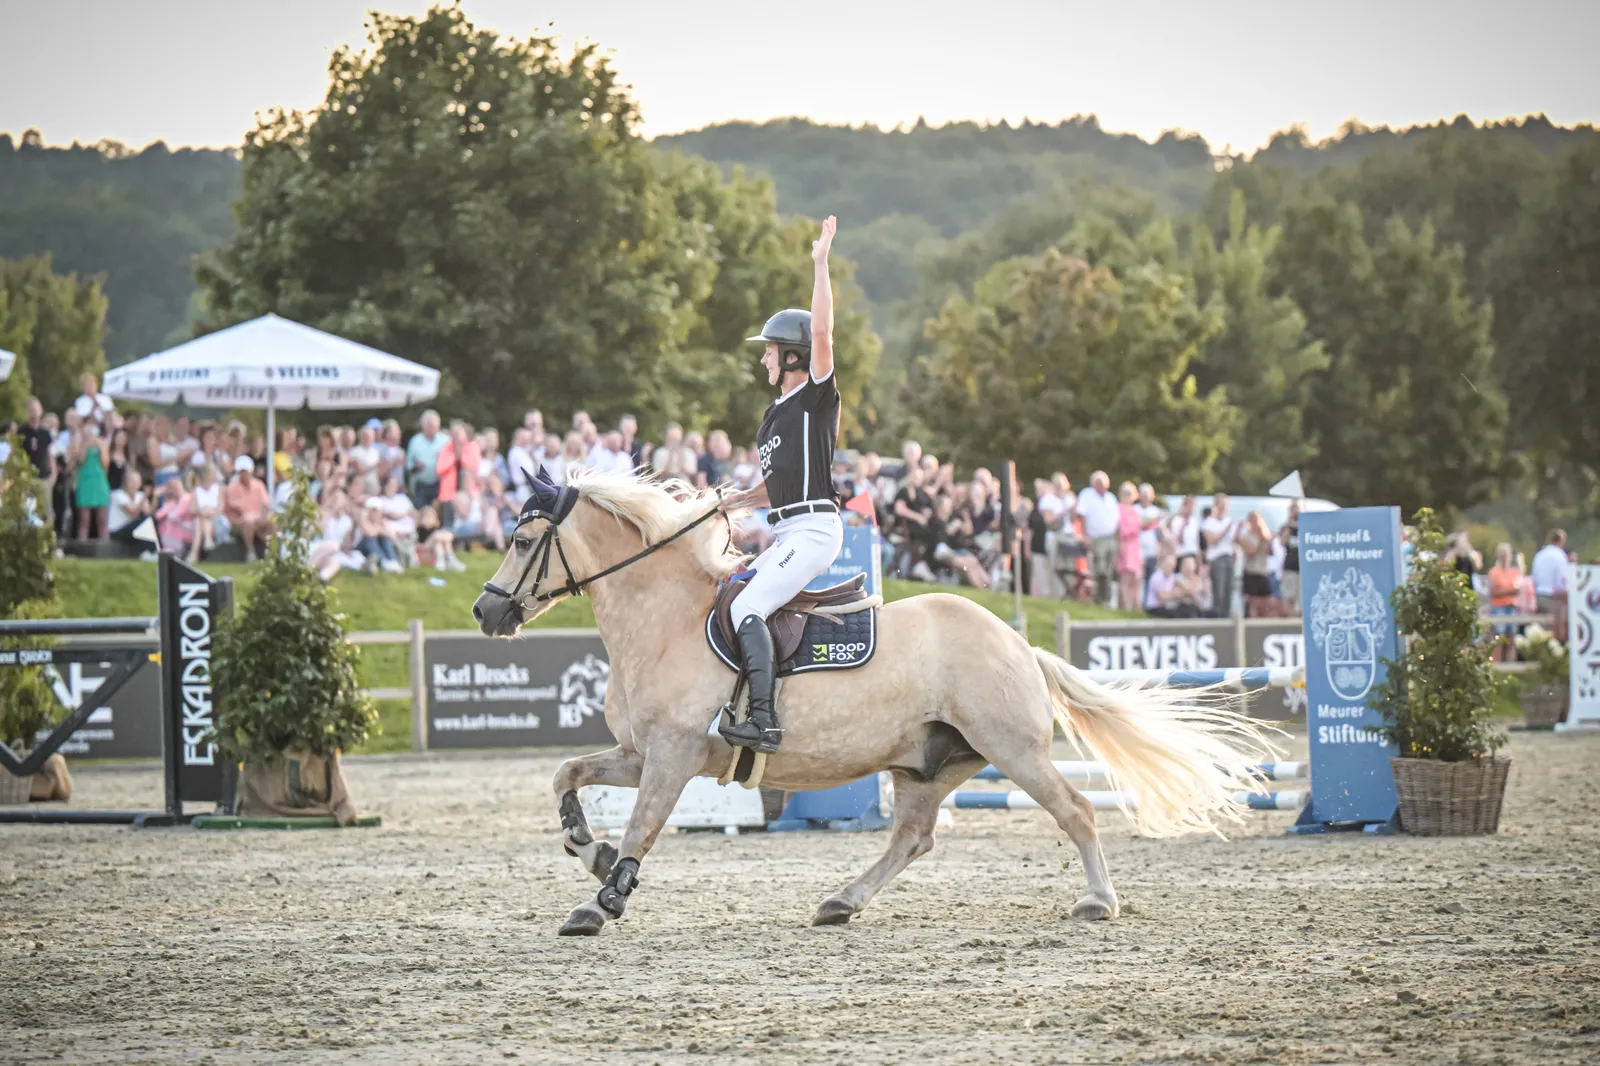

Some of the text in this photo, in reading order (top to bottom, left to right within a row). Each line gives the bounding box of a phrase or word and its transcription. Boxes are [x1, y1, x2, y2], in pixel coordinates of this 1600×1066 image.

[1304, 529, 1371, 544] Franz-Josef &
[1305, 547, 1384, 562] Christel Meurer
[828, 642, 867, 653] FOOD
[1087, 634, 1218, 670] STEVENS
[829, 651, 856, 661] FOX
[178, 582, 216, 766] ESKADRON
[432, 662, 530, 686] Karl Brocks
[1317, 703, 1365, 718] Meurer
[1318, 723, 1389, 748] Stiftung
